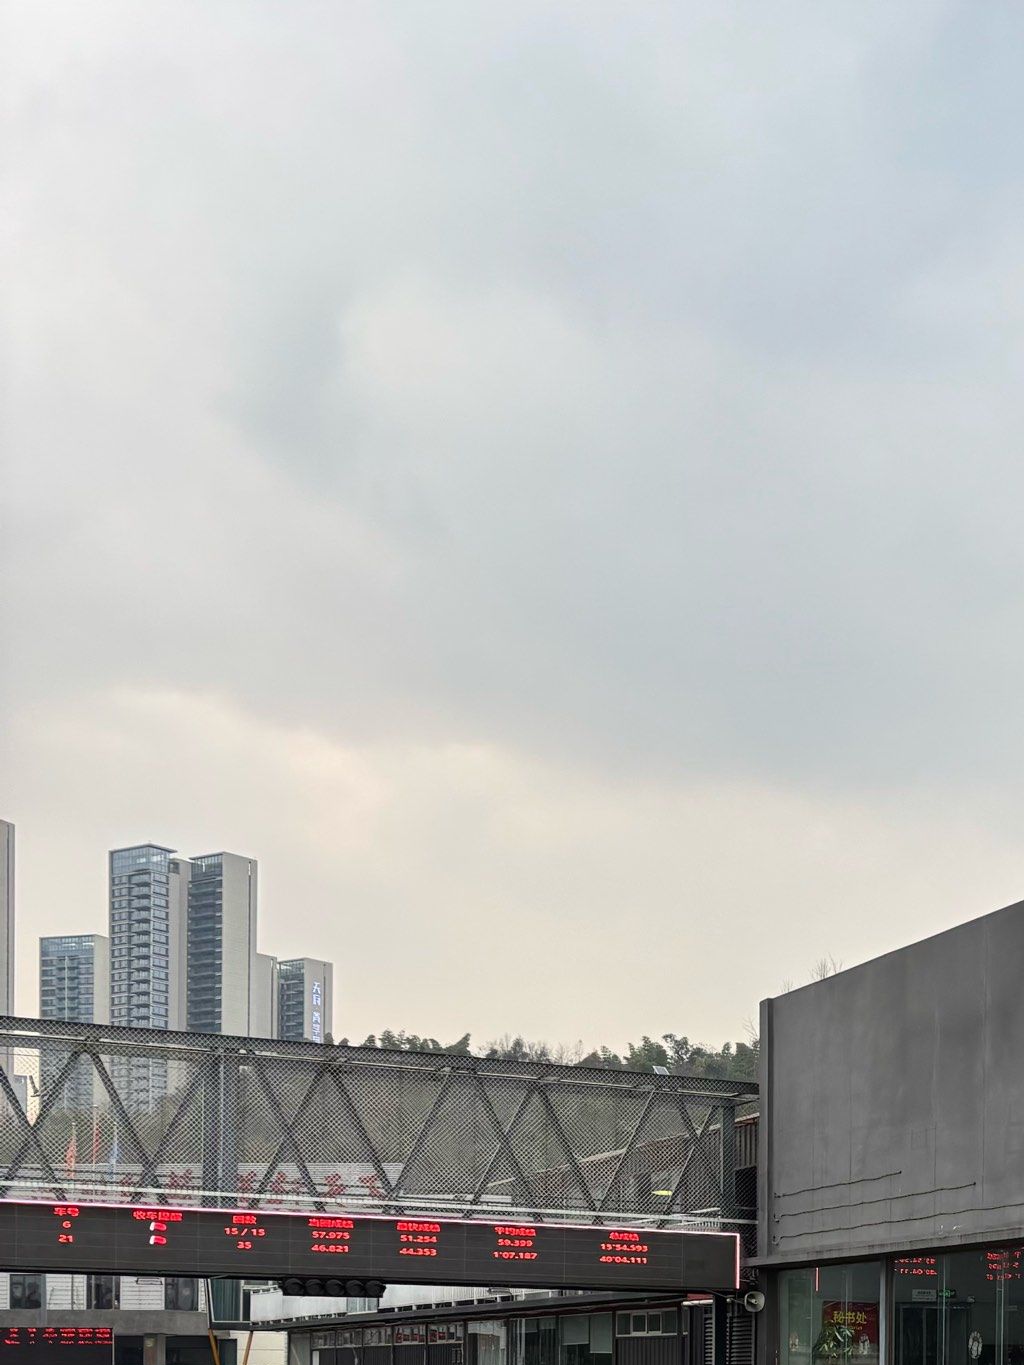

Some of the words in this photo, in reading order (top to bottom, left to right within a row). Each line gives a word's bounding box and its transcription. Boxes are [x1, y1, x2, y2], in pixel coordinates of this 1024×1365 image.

[58, 1234, 74, 1243] 21
[237, 1241, 252, 1250] 35
[311, 1244, 349, 1253] 46.821
[399, 1248, 437, 1257] 44.353
[225, 1227, 239, 1236] 15
[251, 1228, 266, 1237] 15
[312, 1231, 350, 1240] 57.975
[400, 1234, 438, 1243] 51.254
[497, 1238, 533, 1247] 59.399
[833, 1311, 867, 1324] 秘书处
